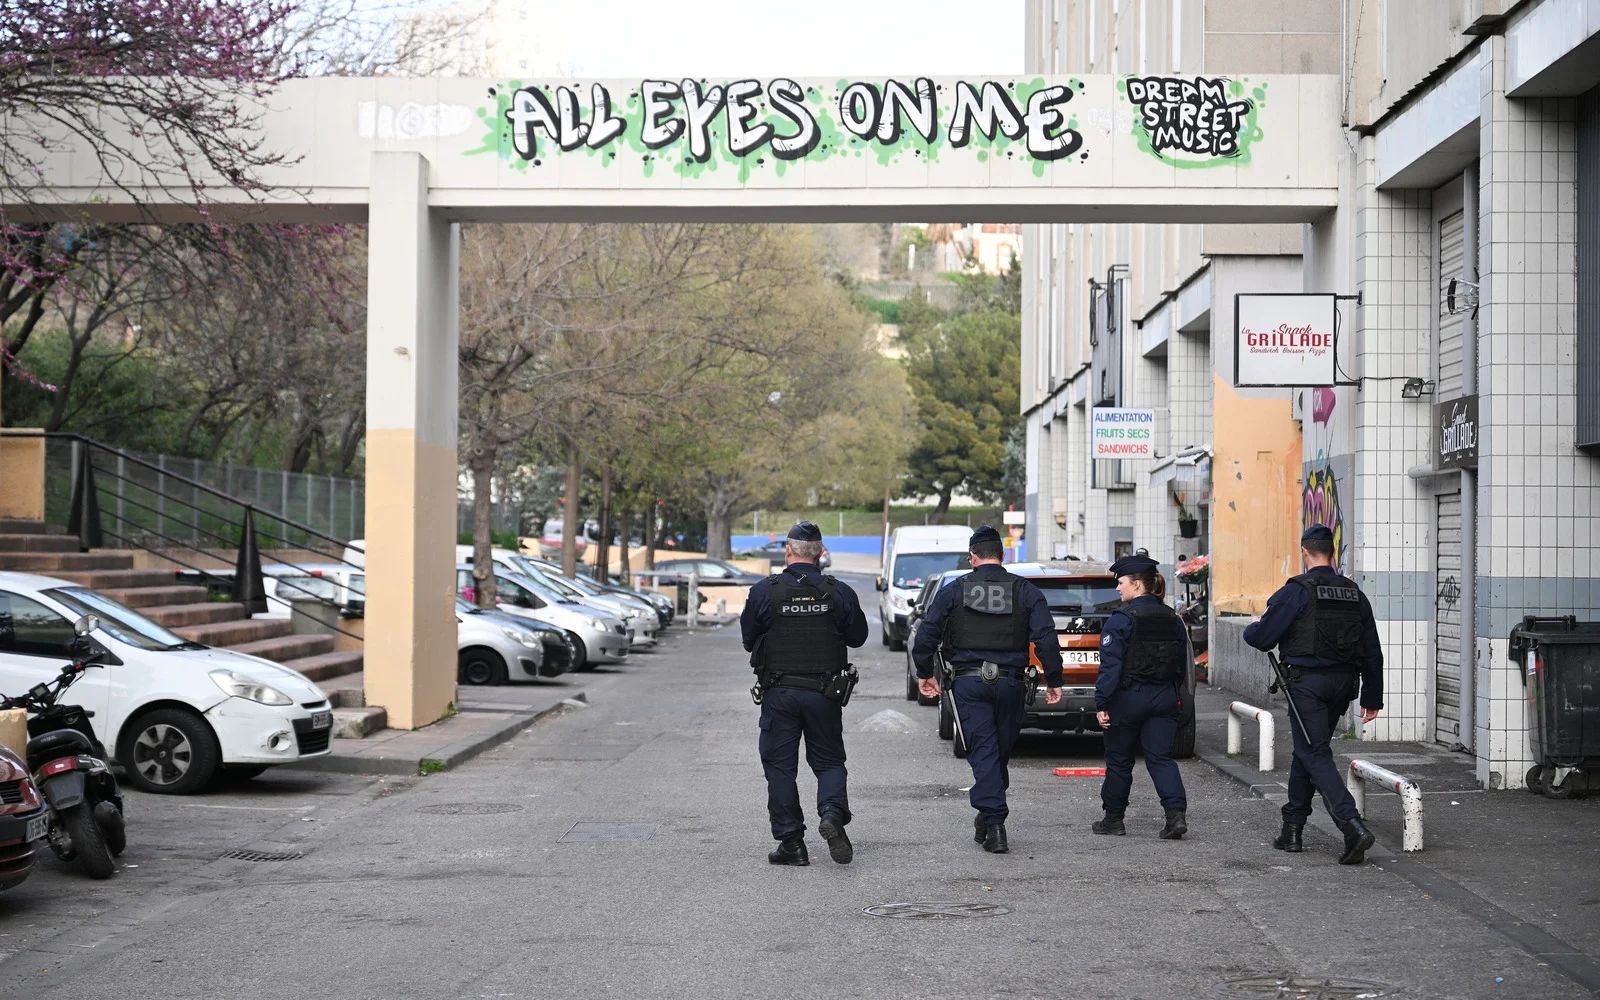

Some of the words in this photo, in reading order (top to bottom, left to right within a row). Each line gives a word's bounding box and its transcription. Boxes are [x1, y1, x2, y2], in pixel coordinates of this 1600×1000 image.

[1127, 77, 1226, 105] DREAM
[506, 82, 627, 160] ALL
[640, 78, 821, 163] EYES
[839, 77, 938, 145] ON
[949, 82, 1083, 160] ME
[1142, 101, 1248, 131] STREET
[1277, 324, 1312, 335] Snack
[1095, 412, 1152, 423] ALIMENTATION
[1096, 428, 1125, 438] FRUITS
[1127, 429, 1150, 439] SECS
[1098, 444, 1148, 454] SANDWICHS
[970, 585, 1006, 611] 2B
[1319, 587, 1358, 600] POLICE
[782, 604, 829, 613] POLICE
